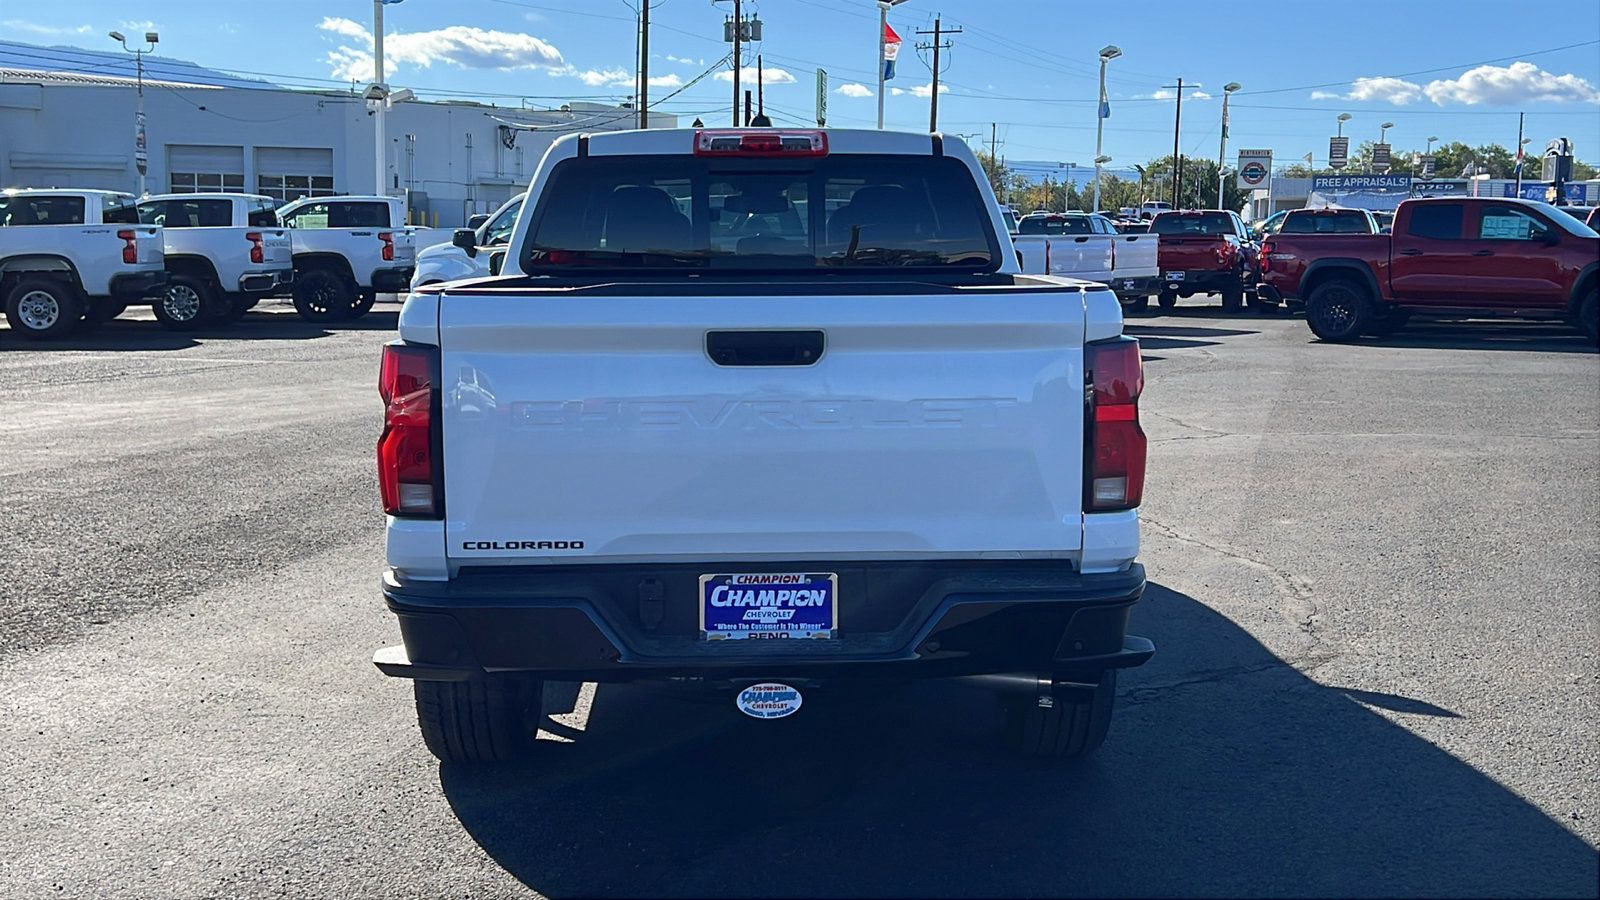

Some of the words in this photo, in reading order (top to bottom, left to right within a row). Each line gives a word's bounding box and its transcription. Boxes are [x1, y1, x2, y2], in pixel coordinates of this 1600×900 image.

[1316, 179, 1341, 187] FREE
[1344, 178, 1408, 187] APPRAISALS!
[511, 398, 1016, 430] CHEVROLET
[463, 541, 584, 550] COLORADO
[737, 575, 800, 584] CHAMPION
[711, 586, 826, 607] CHAMPION
